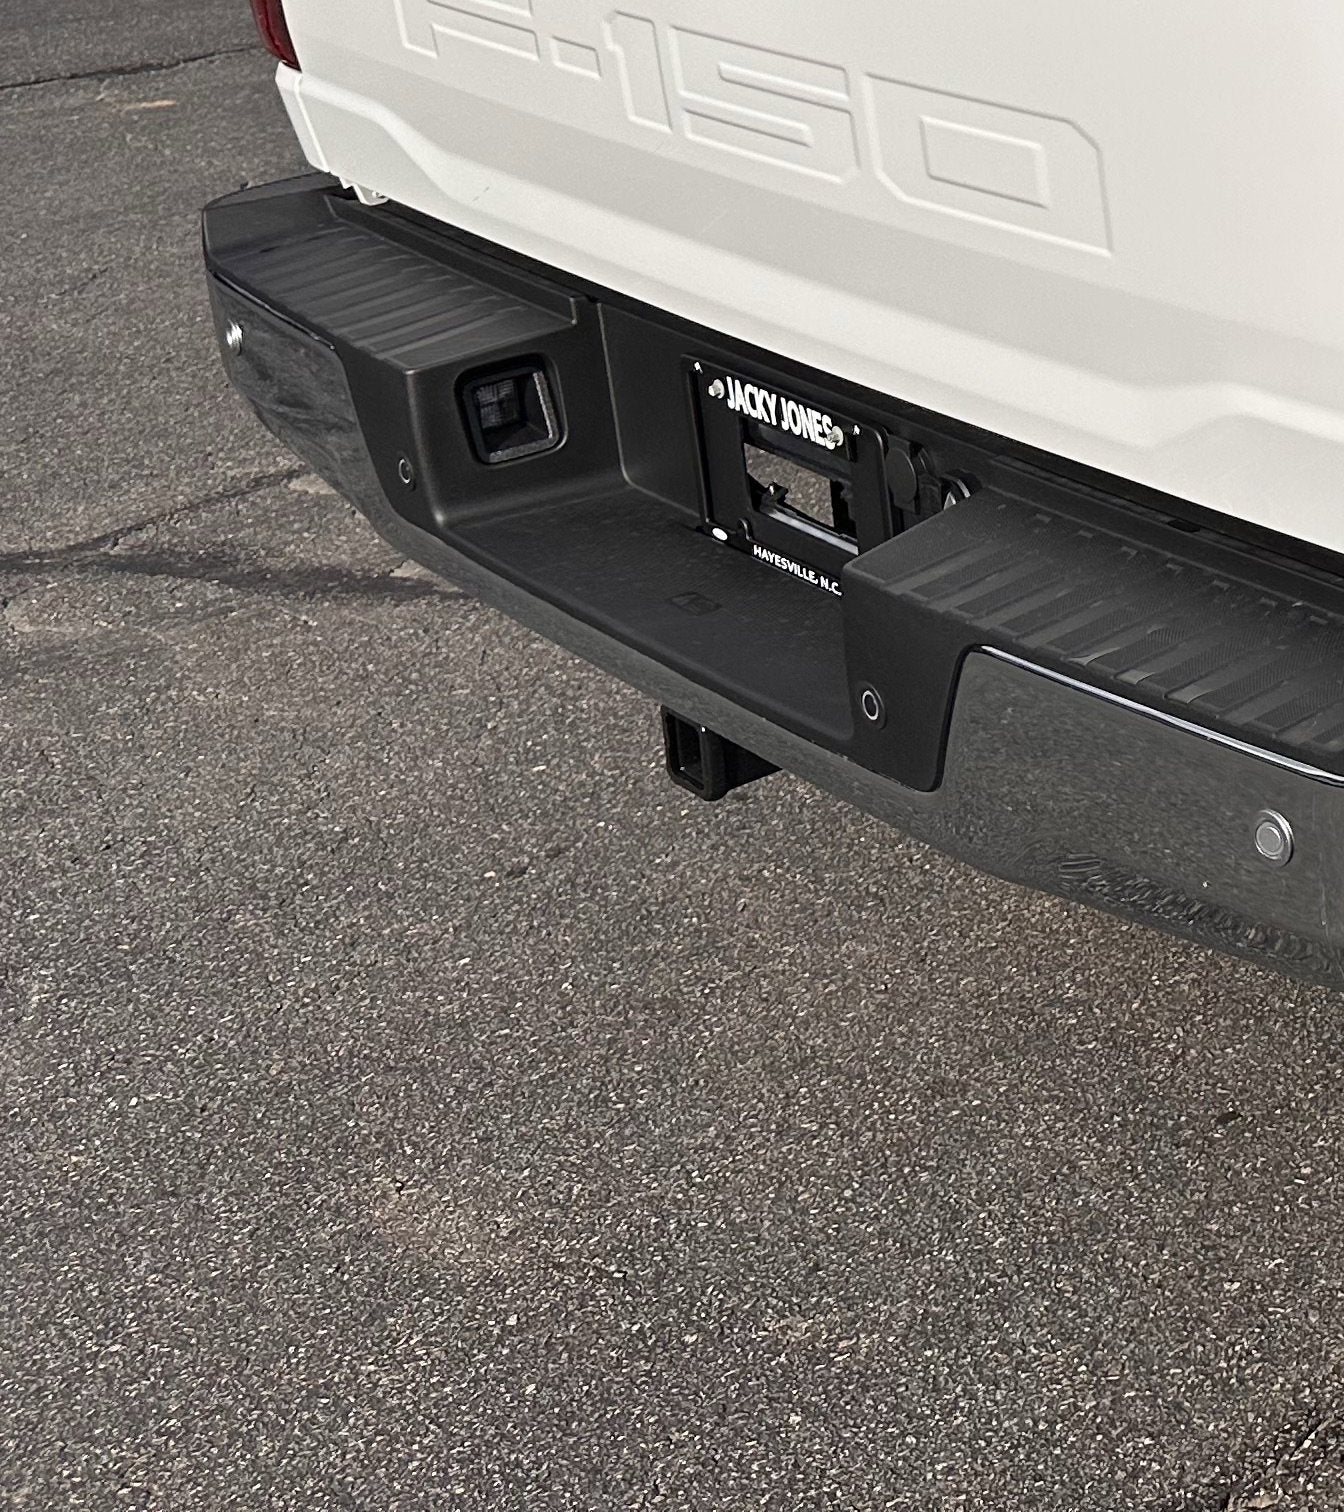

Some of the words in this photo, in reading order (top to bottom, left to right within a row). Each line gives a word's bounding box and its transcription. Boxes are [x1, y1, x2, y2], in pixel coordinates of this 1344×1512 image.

[726, 375, 778, 426] JACKY
[780, 396, 837, 450] JONES
[753, 544, 819, 584] HAYESVILLE,
[819, 575, 843, 597] N.C.
